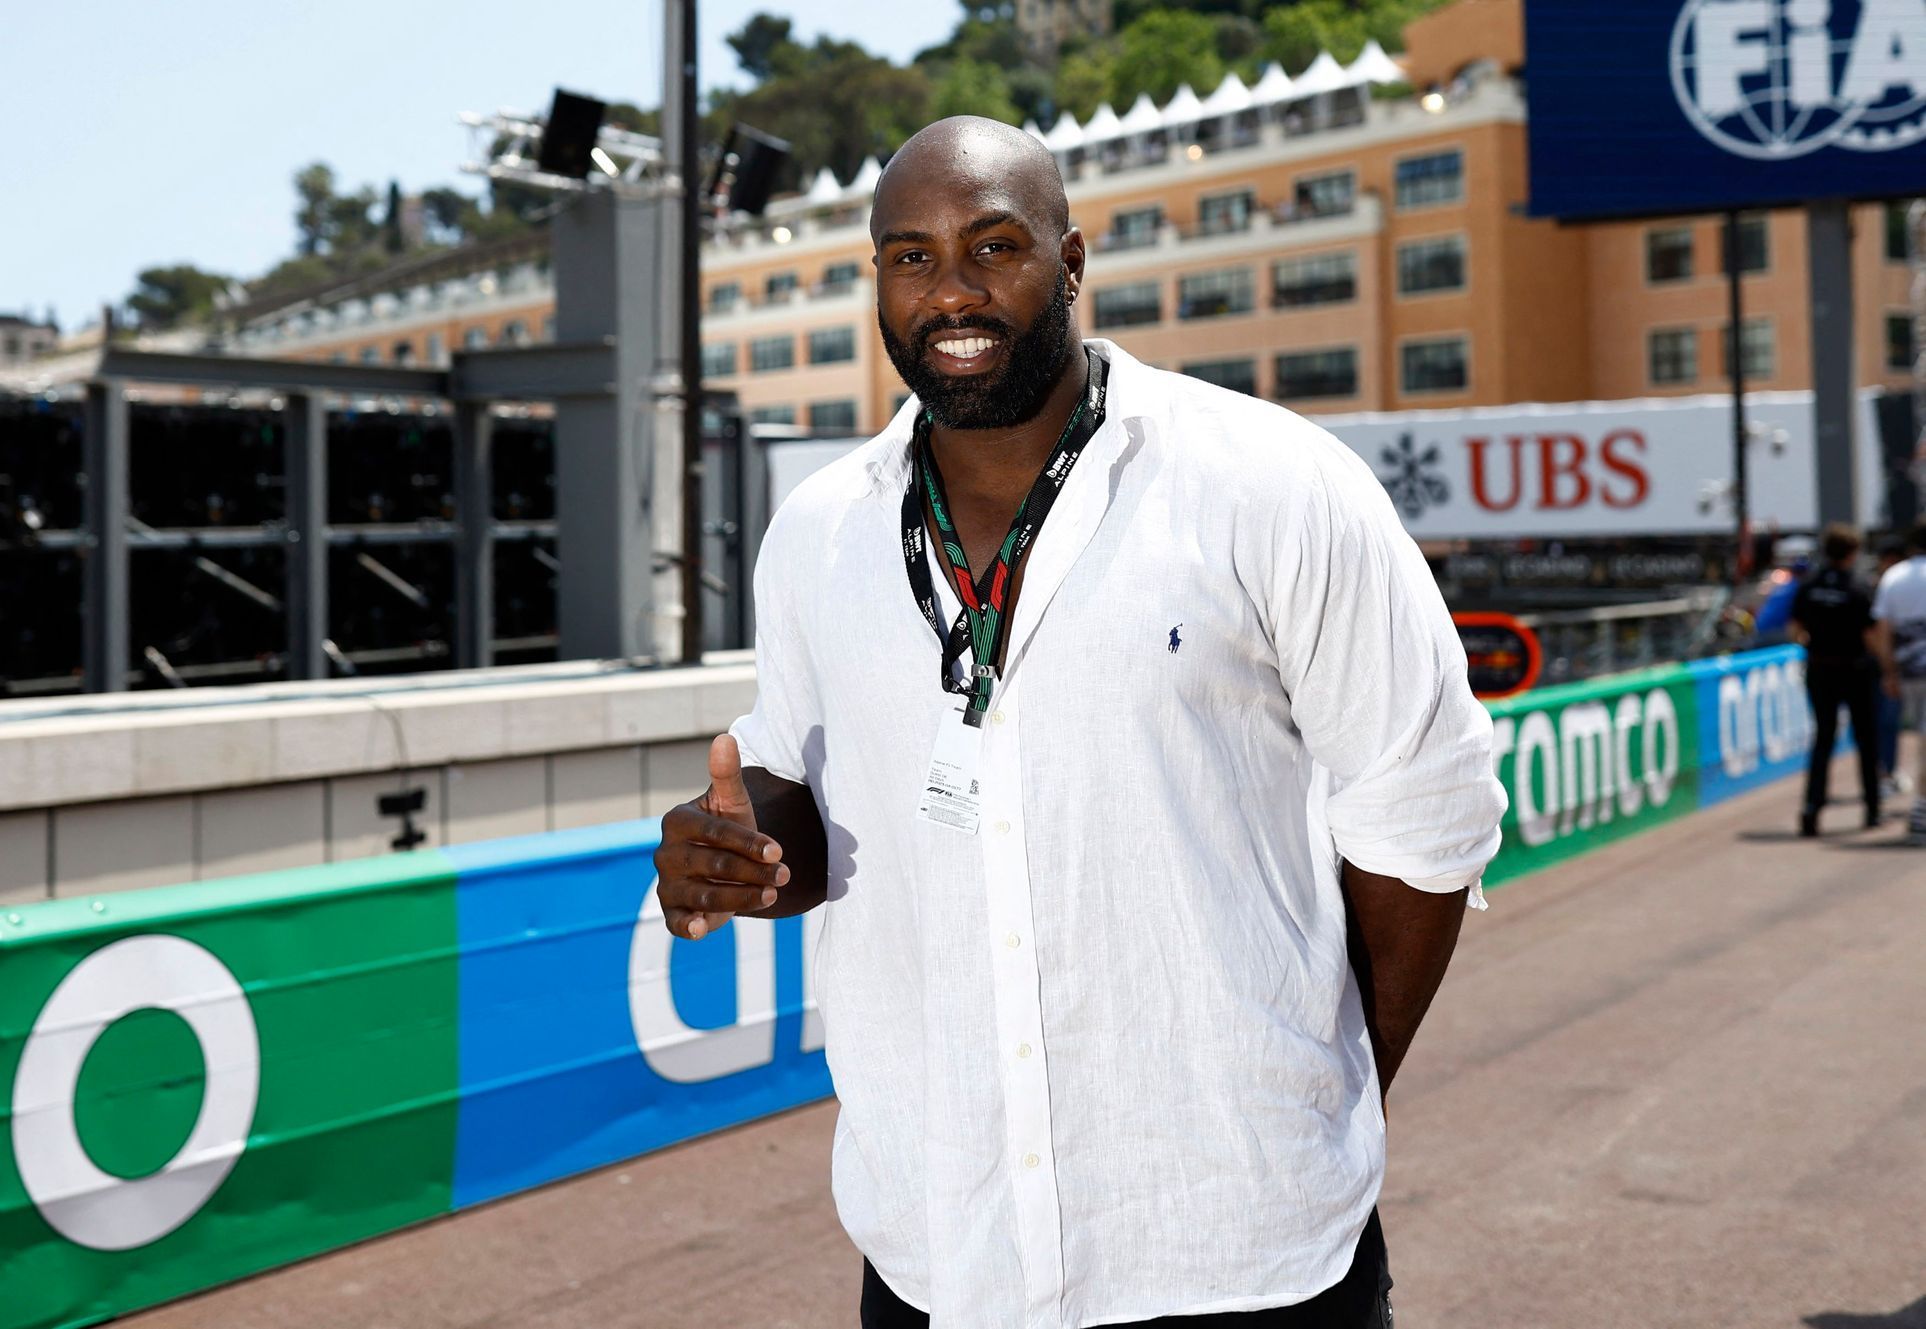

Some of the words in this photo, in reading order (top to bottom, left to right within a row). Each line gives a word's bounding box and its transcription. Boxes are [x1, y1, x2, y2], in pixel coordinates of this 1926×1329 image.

[1090, 386, 1110, 419] ALPINE
[1052, 450, 1069, 471] BWT
[1054, 451, 1078, 487] ALPINE
[1463, 428, 1651, 513] UBS
[904, 528, 919, 563] ALPINE
[913, 534, 923, 553] BWT
[1492, 687, 1679, 846] ramco
